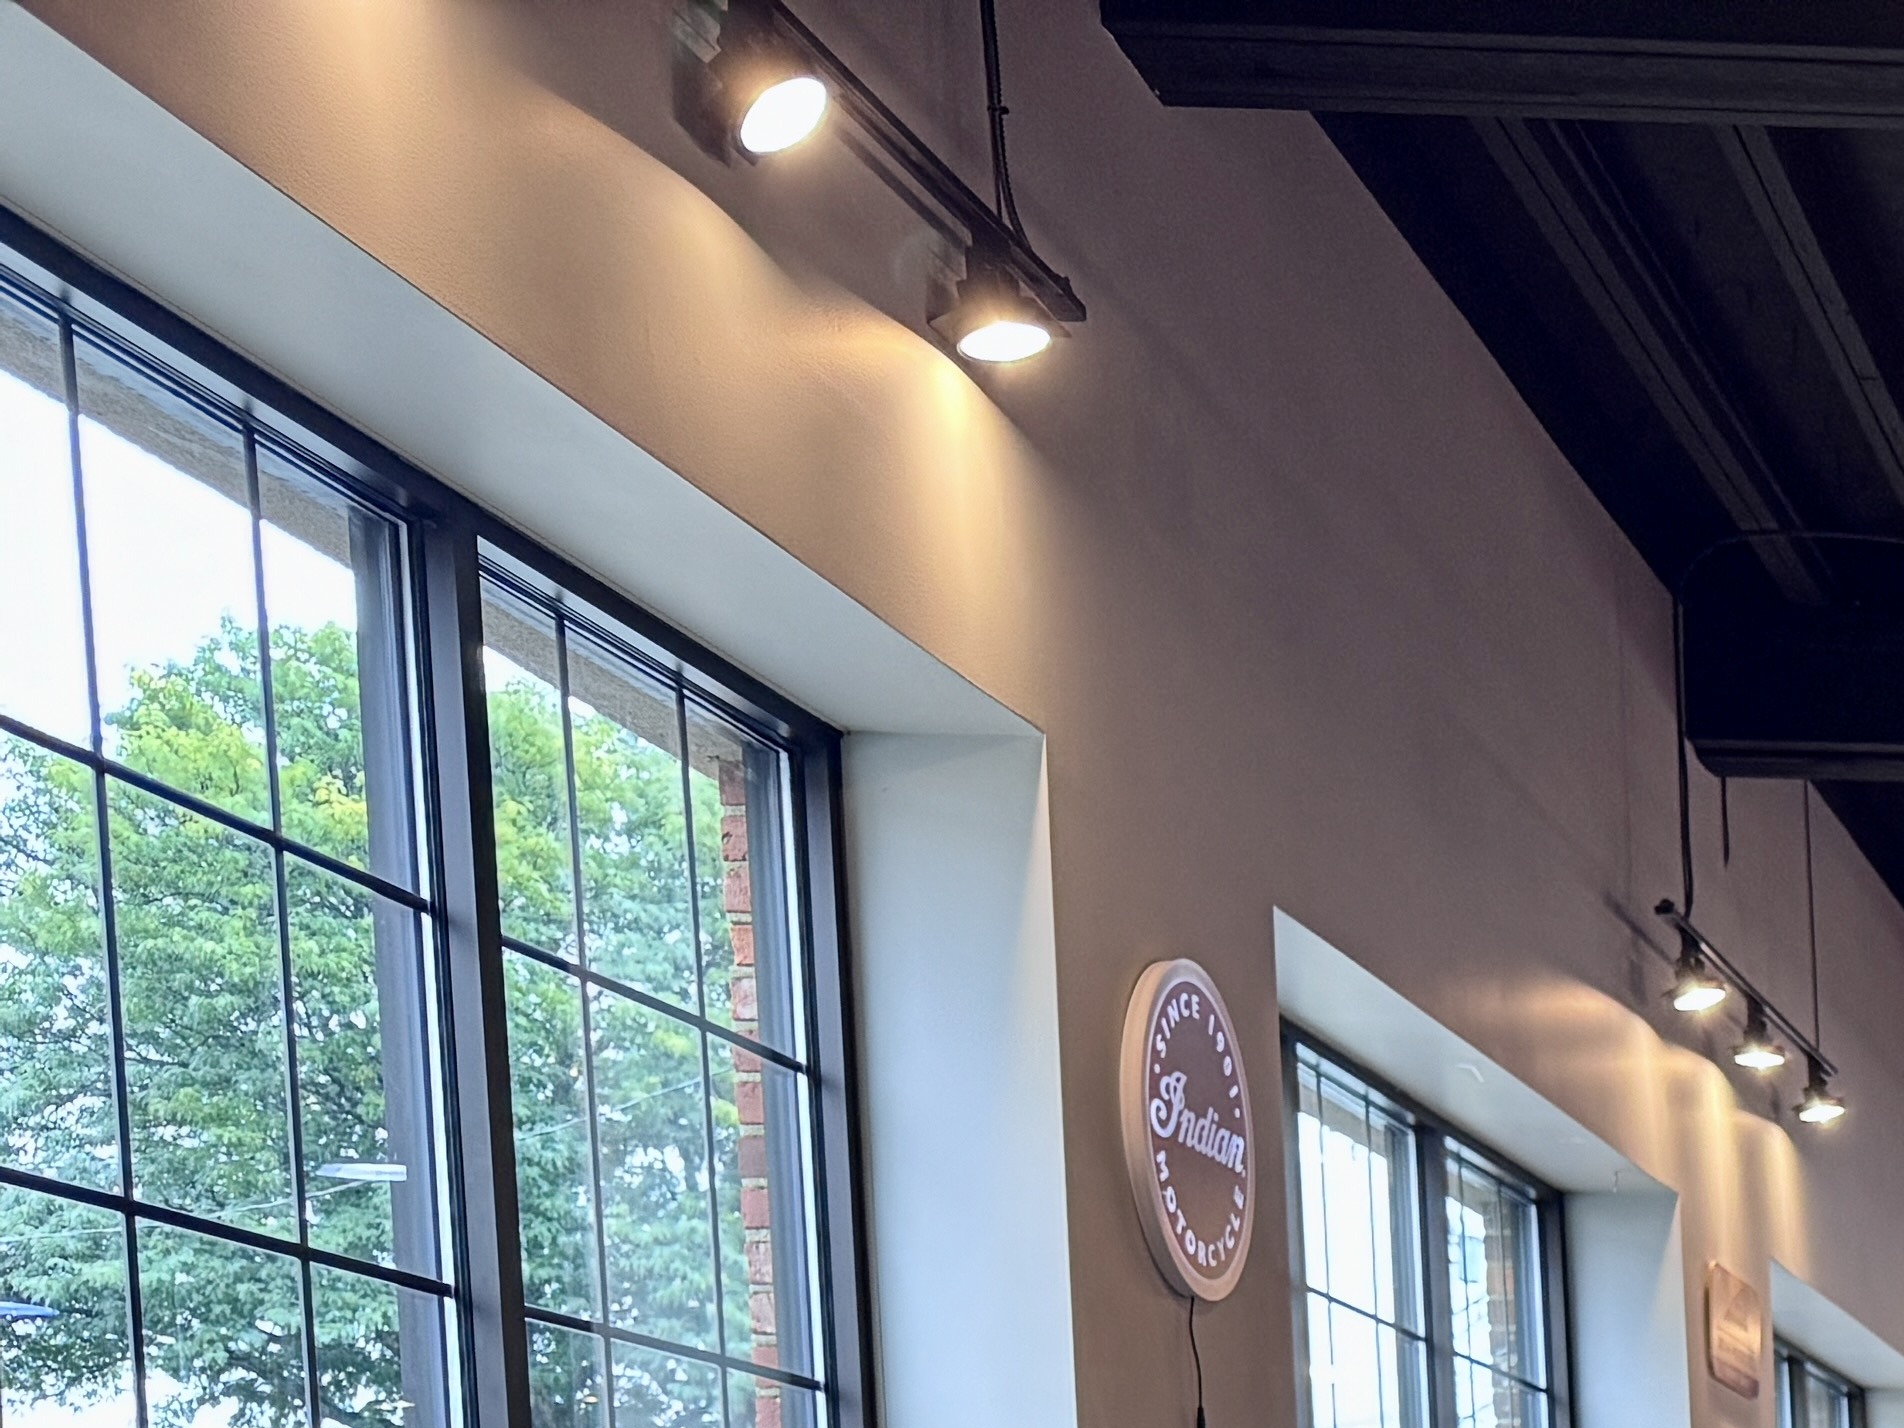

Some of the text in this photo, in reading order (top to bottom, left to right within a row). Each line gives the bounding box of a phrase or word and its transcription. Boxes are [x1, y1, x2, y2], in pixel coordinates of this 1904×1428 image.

[1156, 992, 1240, 1099] SINCE 1901
[1150, 1071, 1245, 1176] Indian
[1156, 1150, 1245, 1267] MOTORCYCLE
